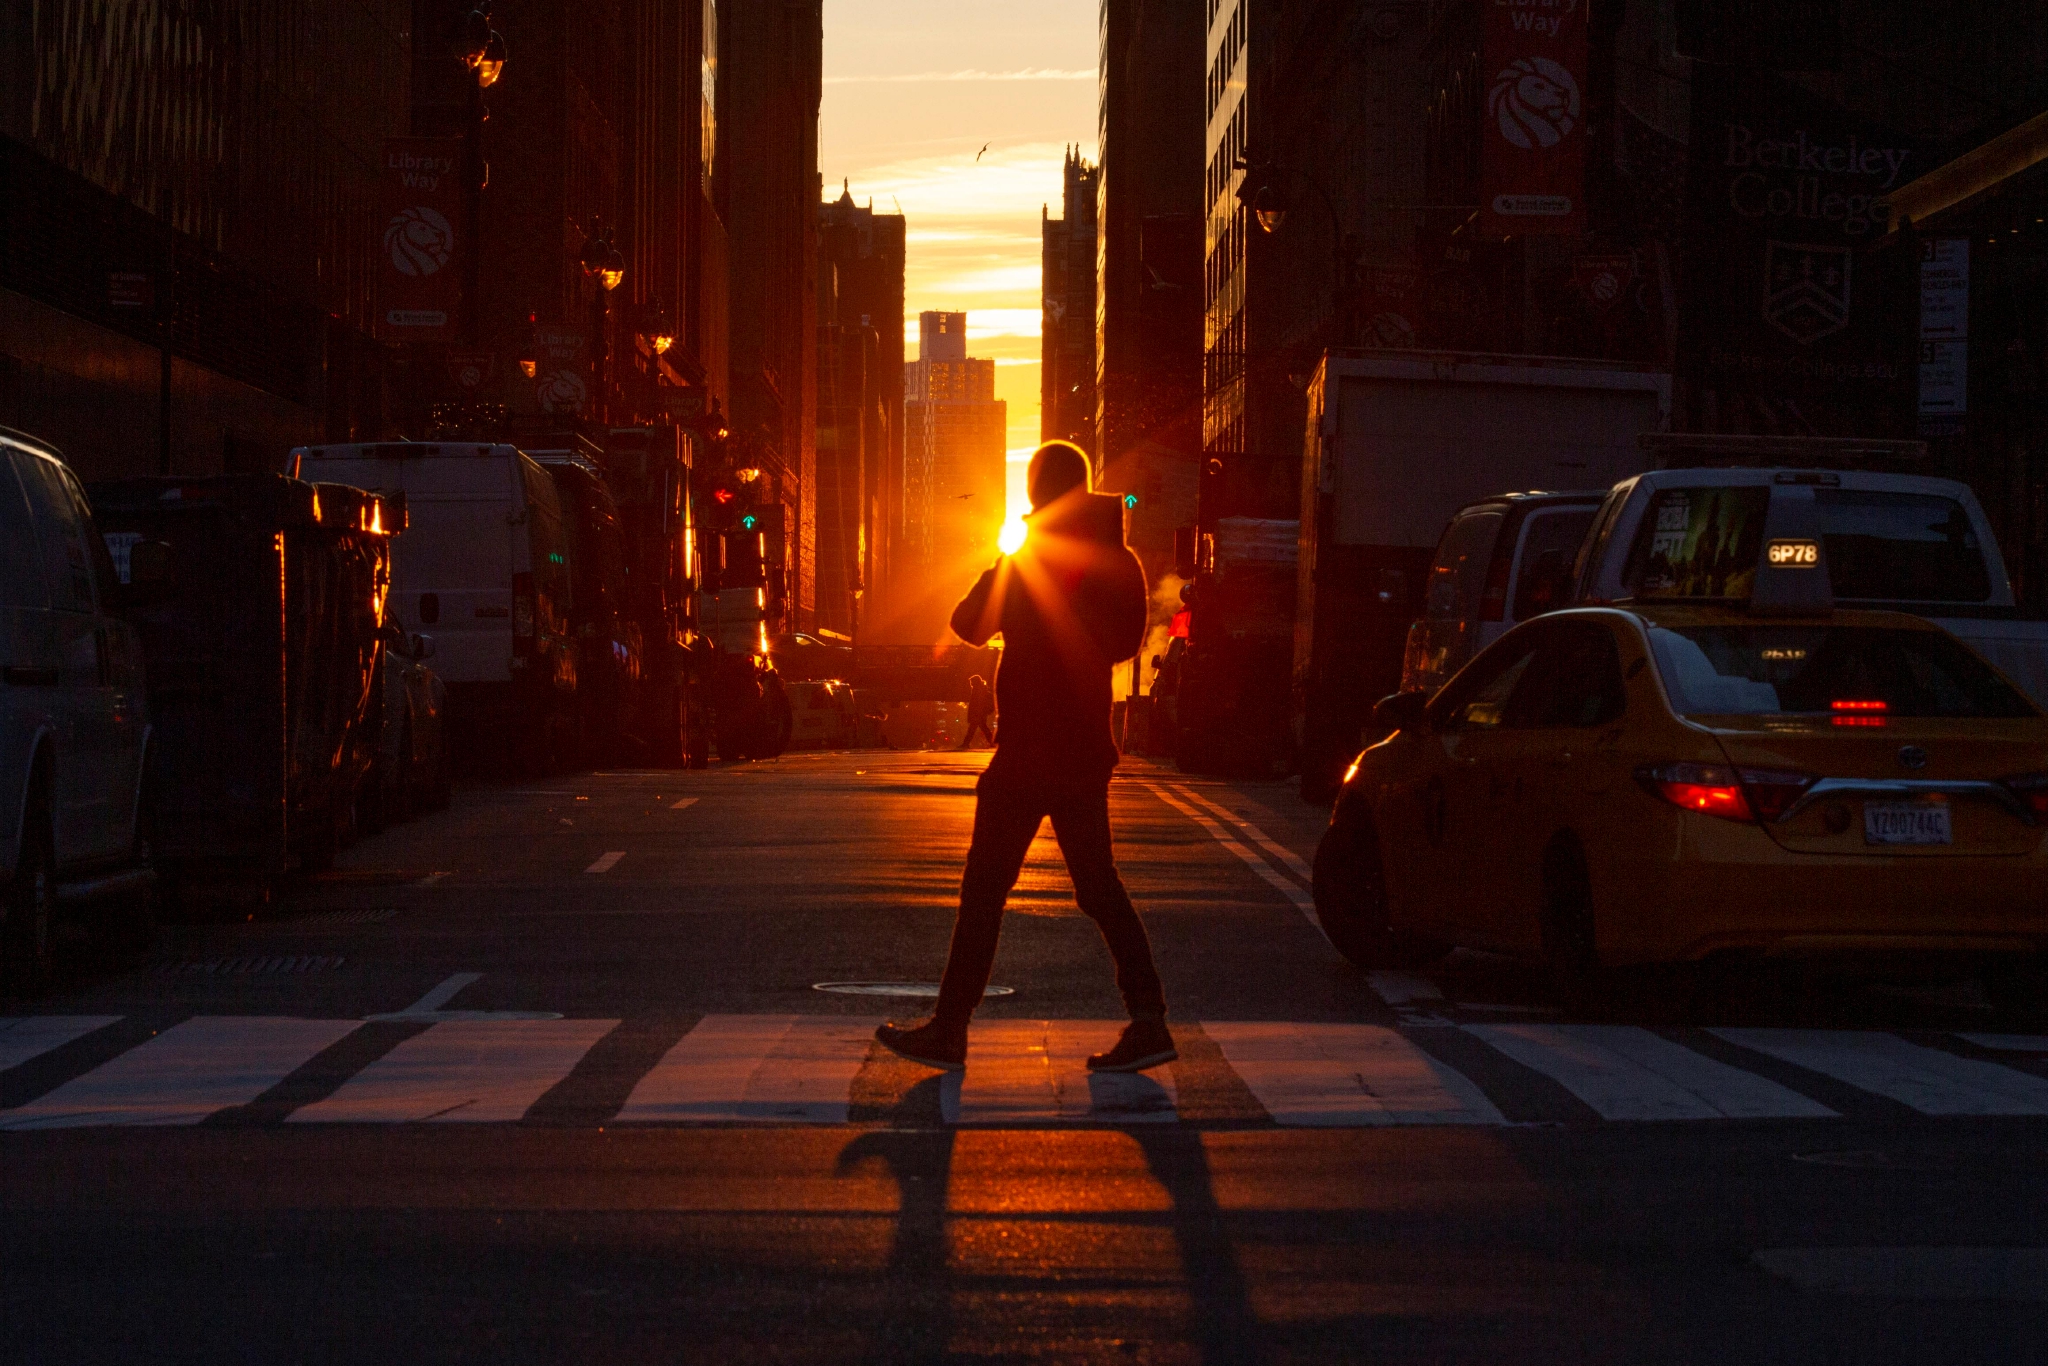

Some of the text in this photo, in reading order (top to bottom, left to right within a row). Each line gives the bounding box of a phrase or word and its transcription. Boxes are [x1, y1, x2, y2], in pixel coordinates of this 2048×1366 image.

[1511, 11, 1562, 38] Way
[388, 152, 454, 175] Library
[1722, 122, 1909, 189] Berkeley
[400, 172, 440, 193] Way
[1729, 171, 1891, 235] College
[539, 334, 585, 349] Library
[549, 346, 576, 361] Way
[1768, 545, 1817, 563] 6P78
